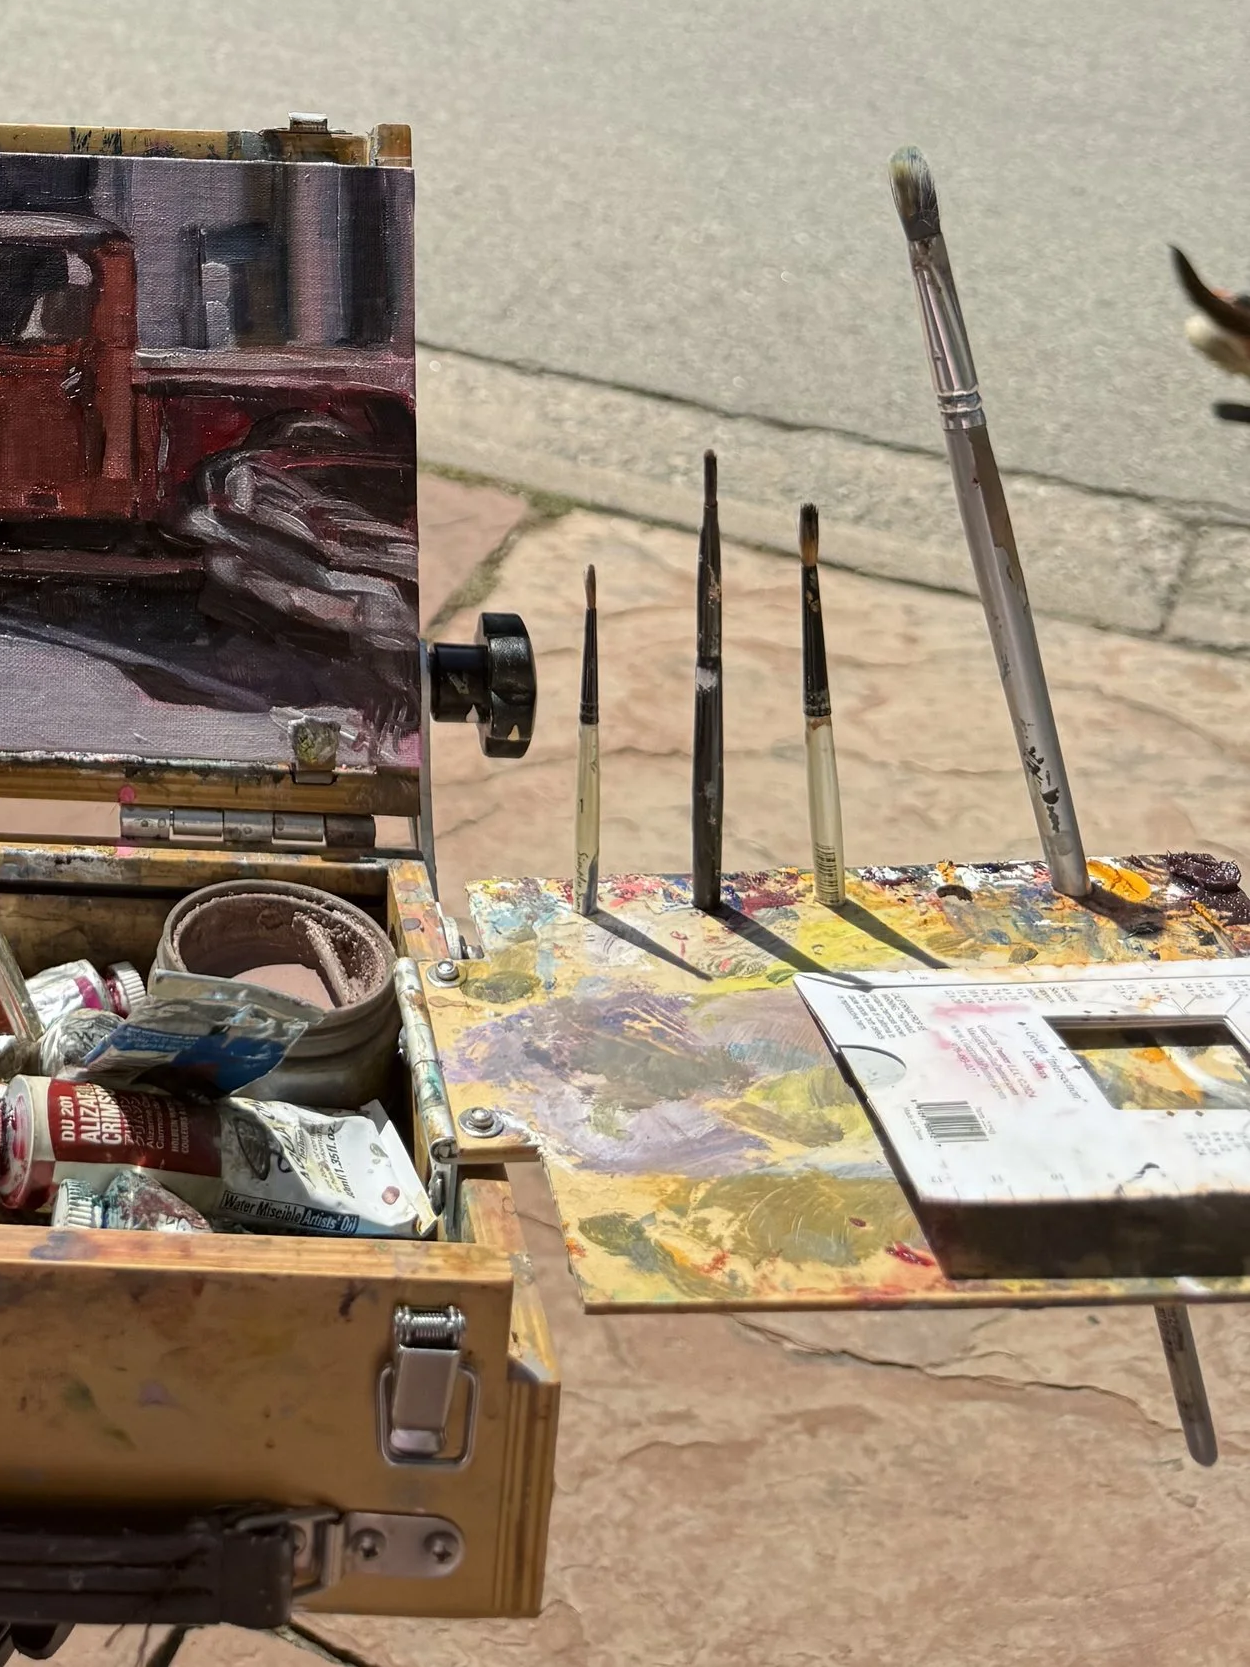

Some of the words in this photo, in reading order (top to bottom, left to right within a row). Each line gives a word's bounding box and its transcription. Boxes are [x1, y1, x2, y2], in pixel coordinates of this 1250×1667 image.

[1025, 1030, 1049, 1055] Golden
[59, 1096, 75, 1117] 201
[60, 1119, 76, 1142] DU
[223, 1193, 256, 1215] Water
[256, 1202, 301, 1223] Miscible
[341, 1215, 358, 1233] Oil
